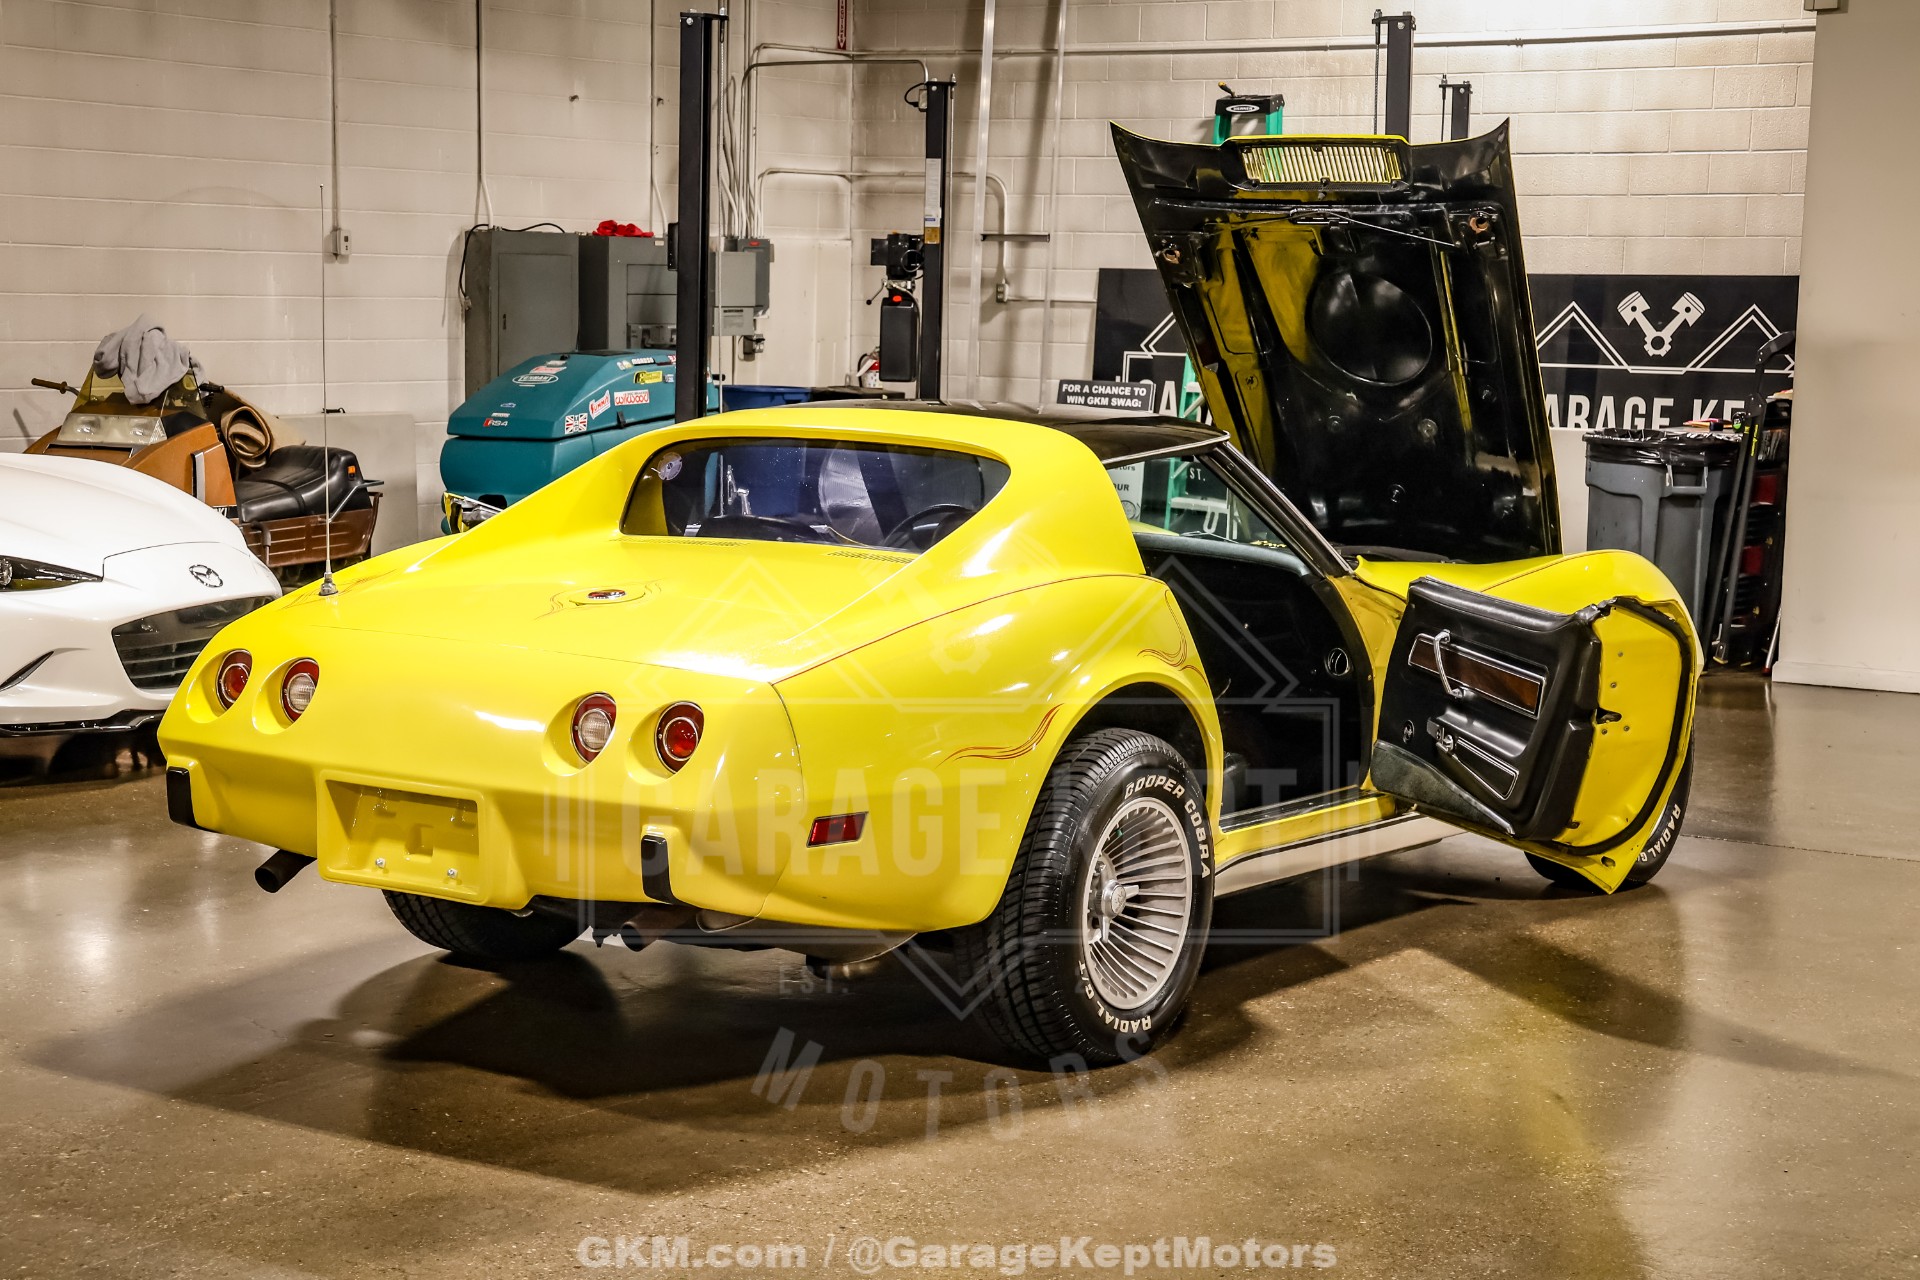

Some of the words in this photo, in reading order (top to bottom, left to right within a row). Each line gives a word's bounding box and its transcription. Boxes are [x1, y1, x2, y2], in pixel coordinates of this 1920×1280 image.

[1062, 384, 1081, 393] FOR
[1083, 384, 1090, 393] A
[1092, 385, 1131, 396] CHANCE
[1134, 387, 1147, 396] TO
[1066, 395, 1085, 404] WIN
[1087, 396, 1109, 406] GKM
[1111, 398, 1141, 408] SWAG:
[1124, 775, 1185, 799] COOPER
[1184, 799, 1211, 879] COBRA
[1647, 804, 1682, 858] RADIAL
[1096, 1001, 1152, 1034] RADIAL
